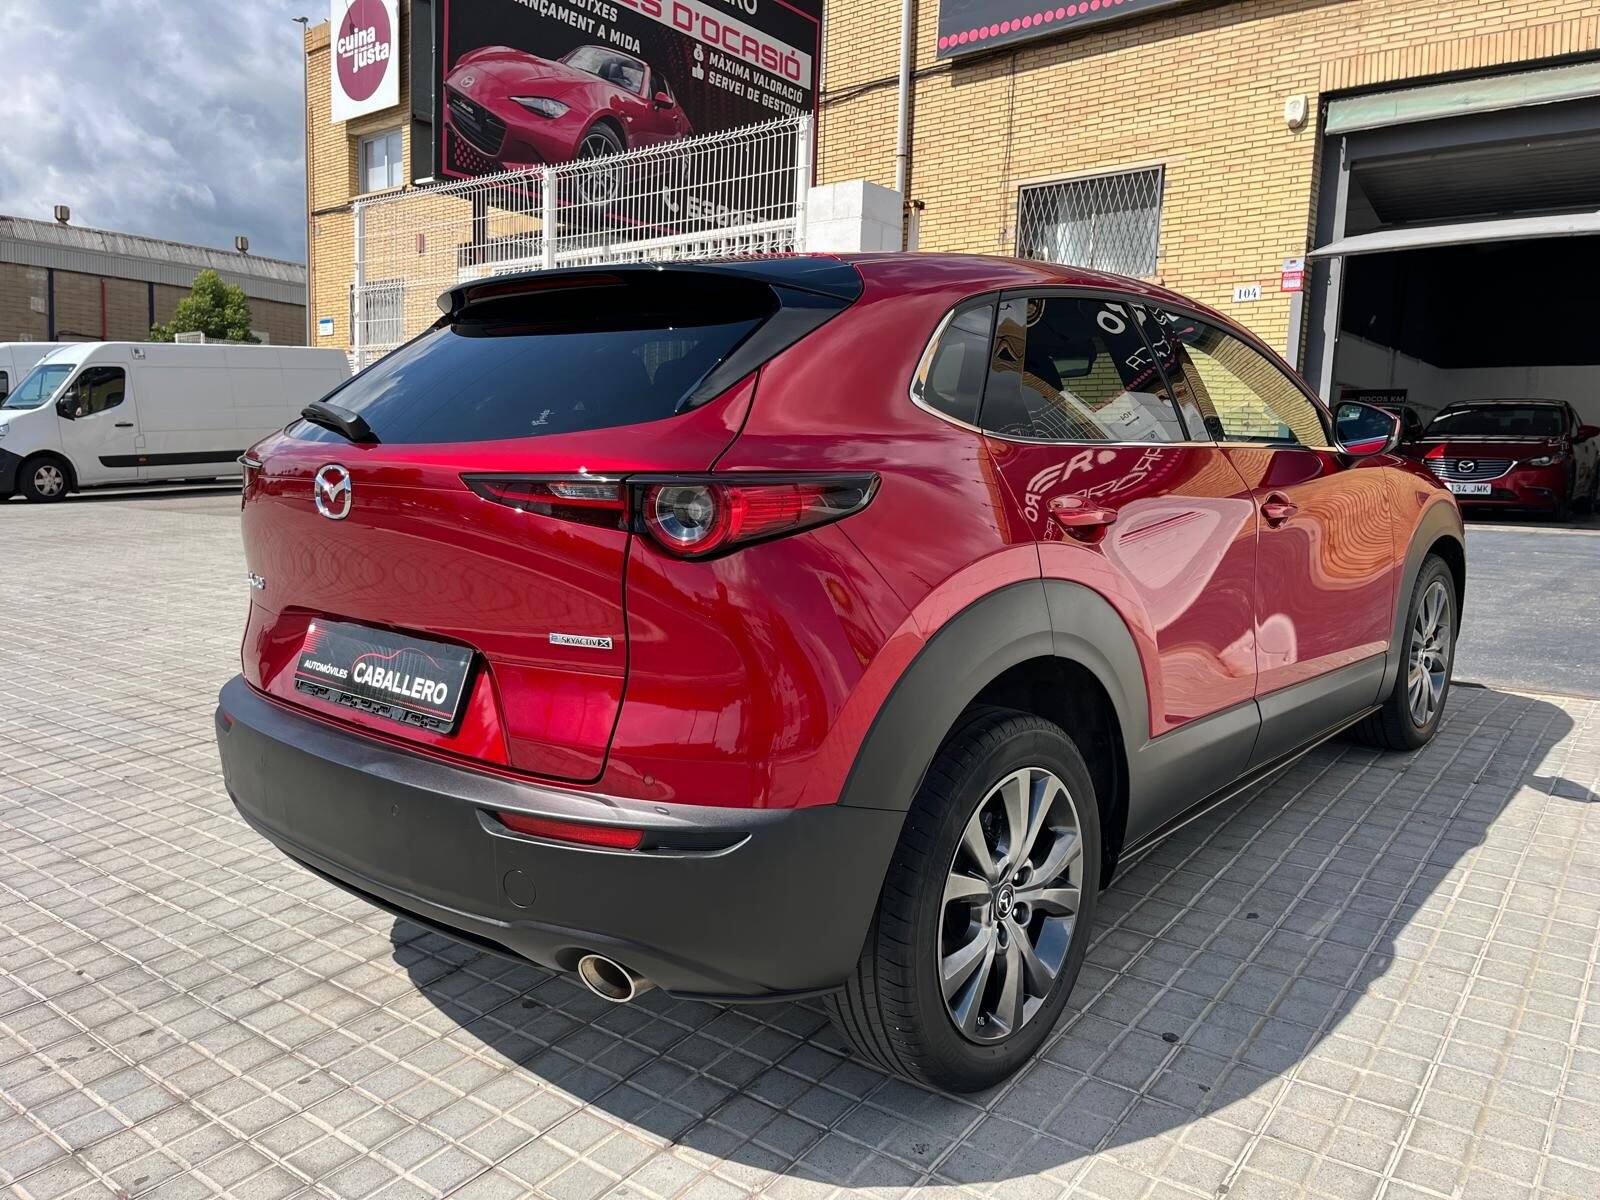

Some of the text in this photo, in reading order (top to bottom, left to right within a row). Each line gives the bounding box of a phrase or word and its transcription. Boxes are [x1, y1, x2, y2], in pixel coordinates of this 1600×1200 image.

[337, 26, 376, 54] cuina
[513, 0, 640, 53] ANÇAMENT A MIDA
[672, 1, 801, 81] D'OCASIÓ
[353, 41, 390, 73] justa
[708, 71, 744, 96] SERVEI
[747, 87, 759, 102] DE
[709, 53, 803, 103] MÀXIMA VALORACIÓ
[1238, 288, 1257, 299] 104
[1471, 484, 1489, 493] JMK
[303, 659, 448, 705] AUTOMÓVILES CABALLERO
